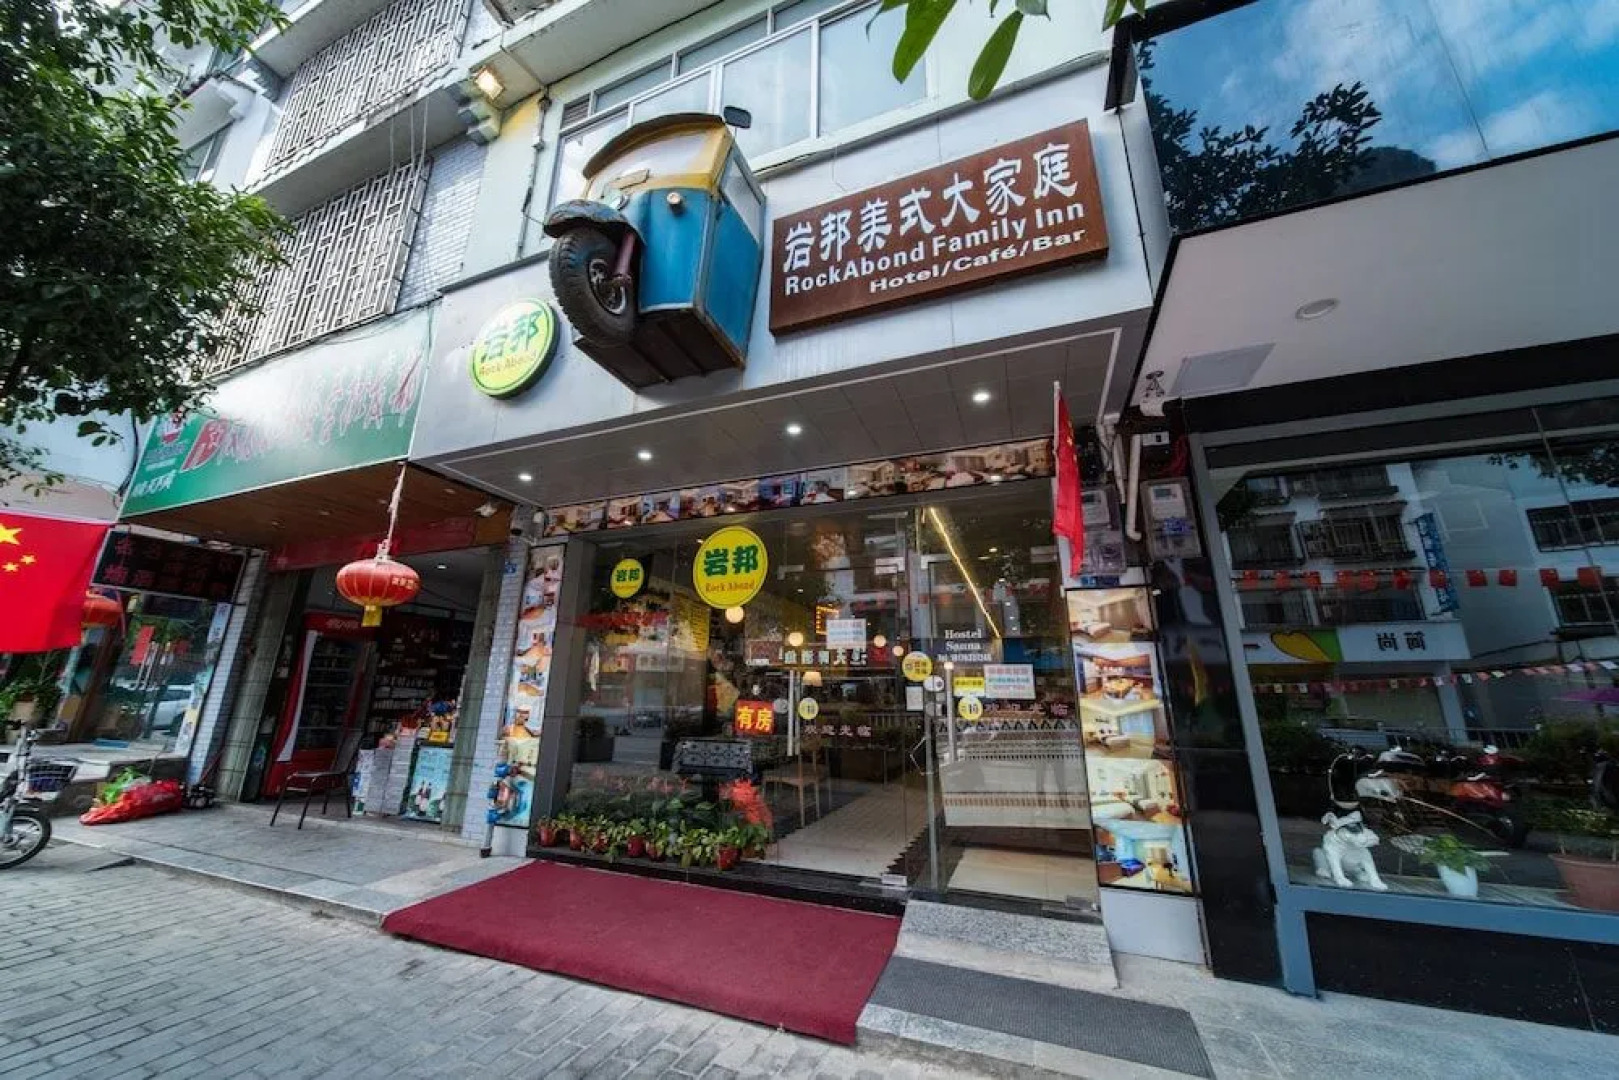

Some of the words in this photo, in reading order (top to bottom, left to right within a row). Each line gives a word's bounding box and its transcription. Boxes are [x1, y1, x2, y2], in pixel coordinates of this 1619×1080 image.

[782, 142, 1079, 273] 岩邦美式大家庭
[784, 240, 926, 296] RockAbond
[932, 216, 1027, 258] Family
[1035, 202, 1085, 230] Inn
[869, 229, 1087, 294] Hotel/Café/Bar
[480, 310, 544, 364] 岩邦
[616, 568, 640, 582] 岩邦
[703, 544, 760, 577] 岩邦
[944, 628, 982, 639] Hostel
[737, 705, 774, 732] 有房
